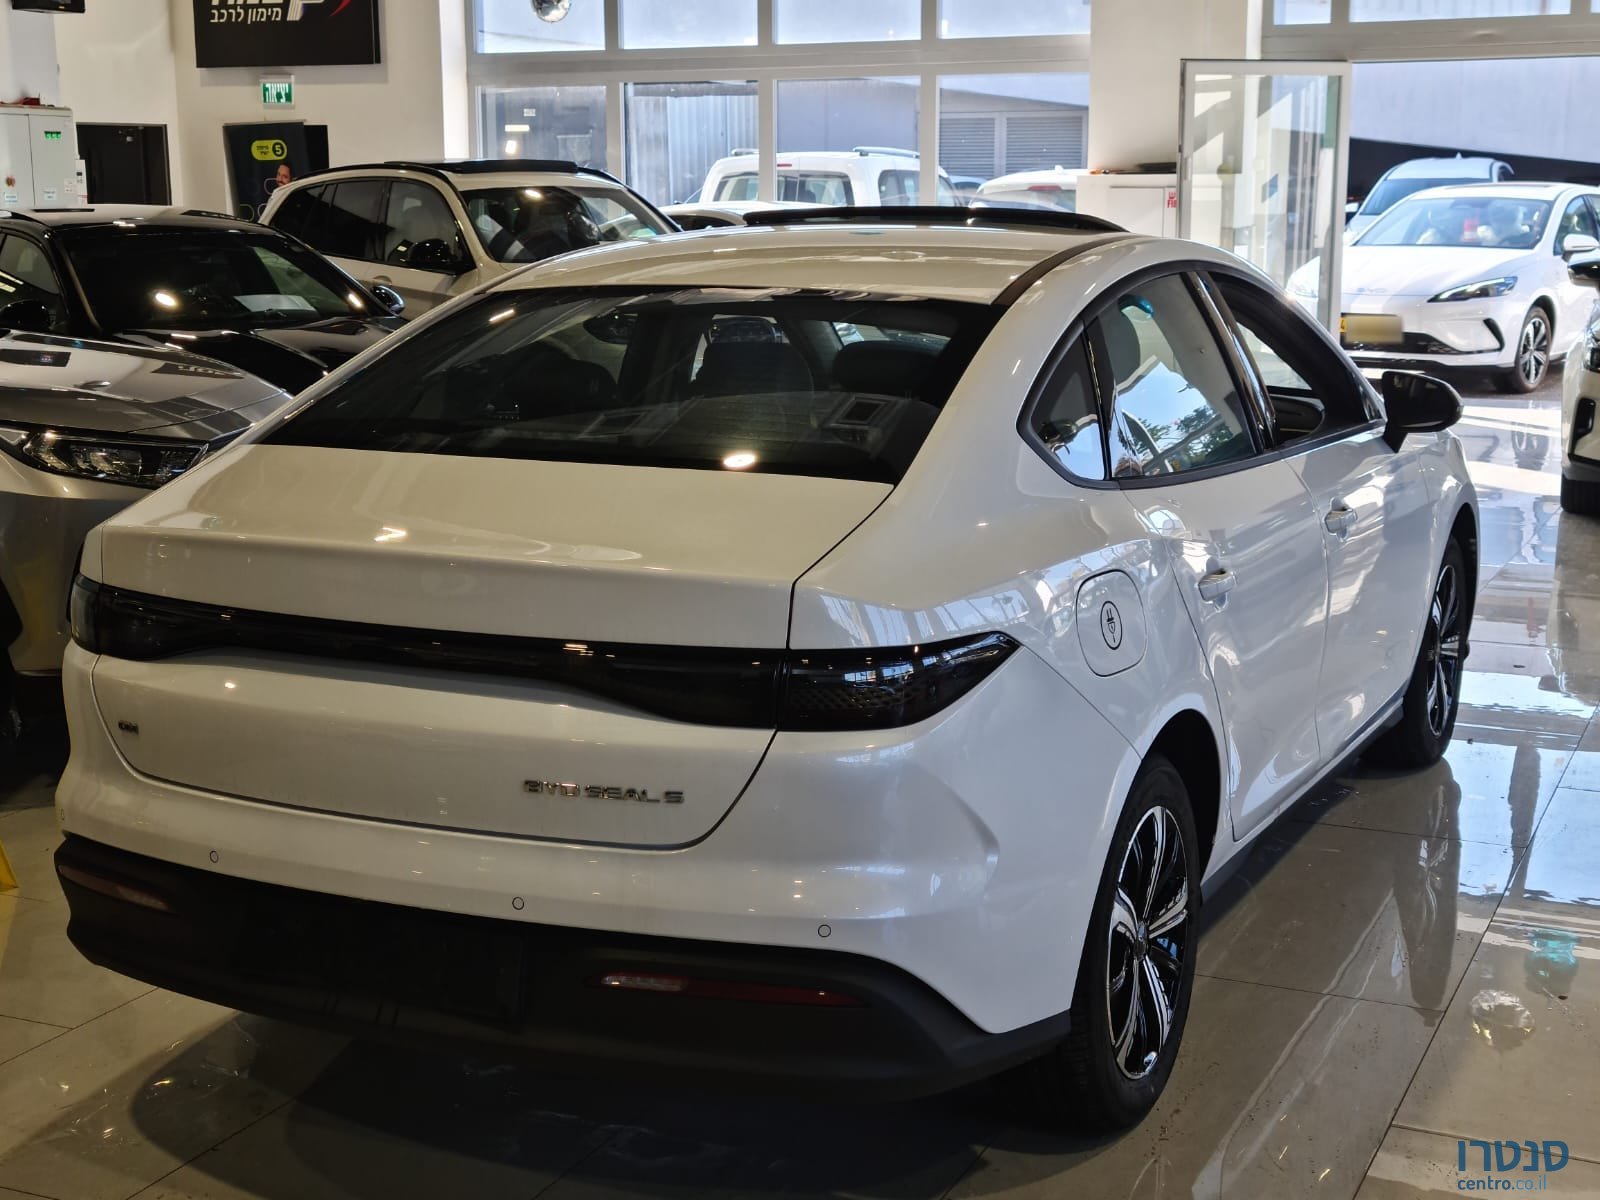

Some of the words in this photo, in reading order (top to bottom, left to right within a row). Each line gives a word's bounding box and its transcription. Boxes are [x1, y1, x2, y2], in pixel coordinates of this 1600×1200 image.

[210, 6, 245, 23] לרכב
[247, 7, 282, 24] מימון
[265, 83, 289, 103] יציאה
[523, 779, 580, 797] BYD
[585, 784, 661, 803] SEAL
